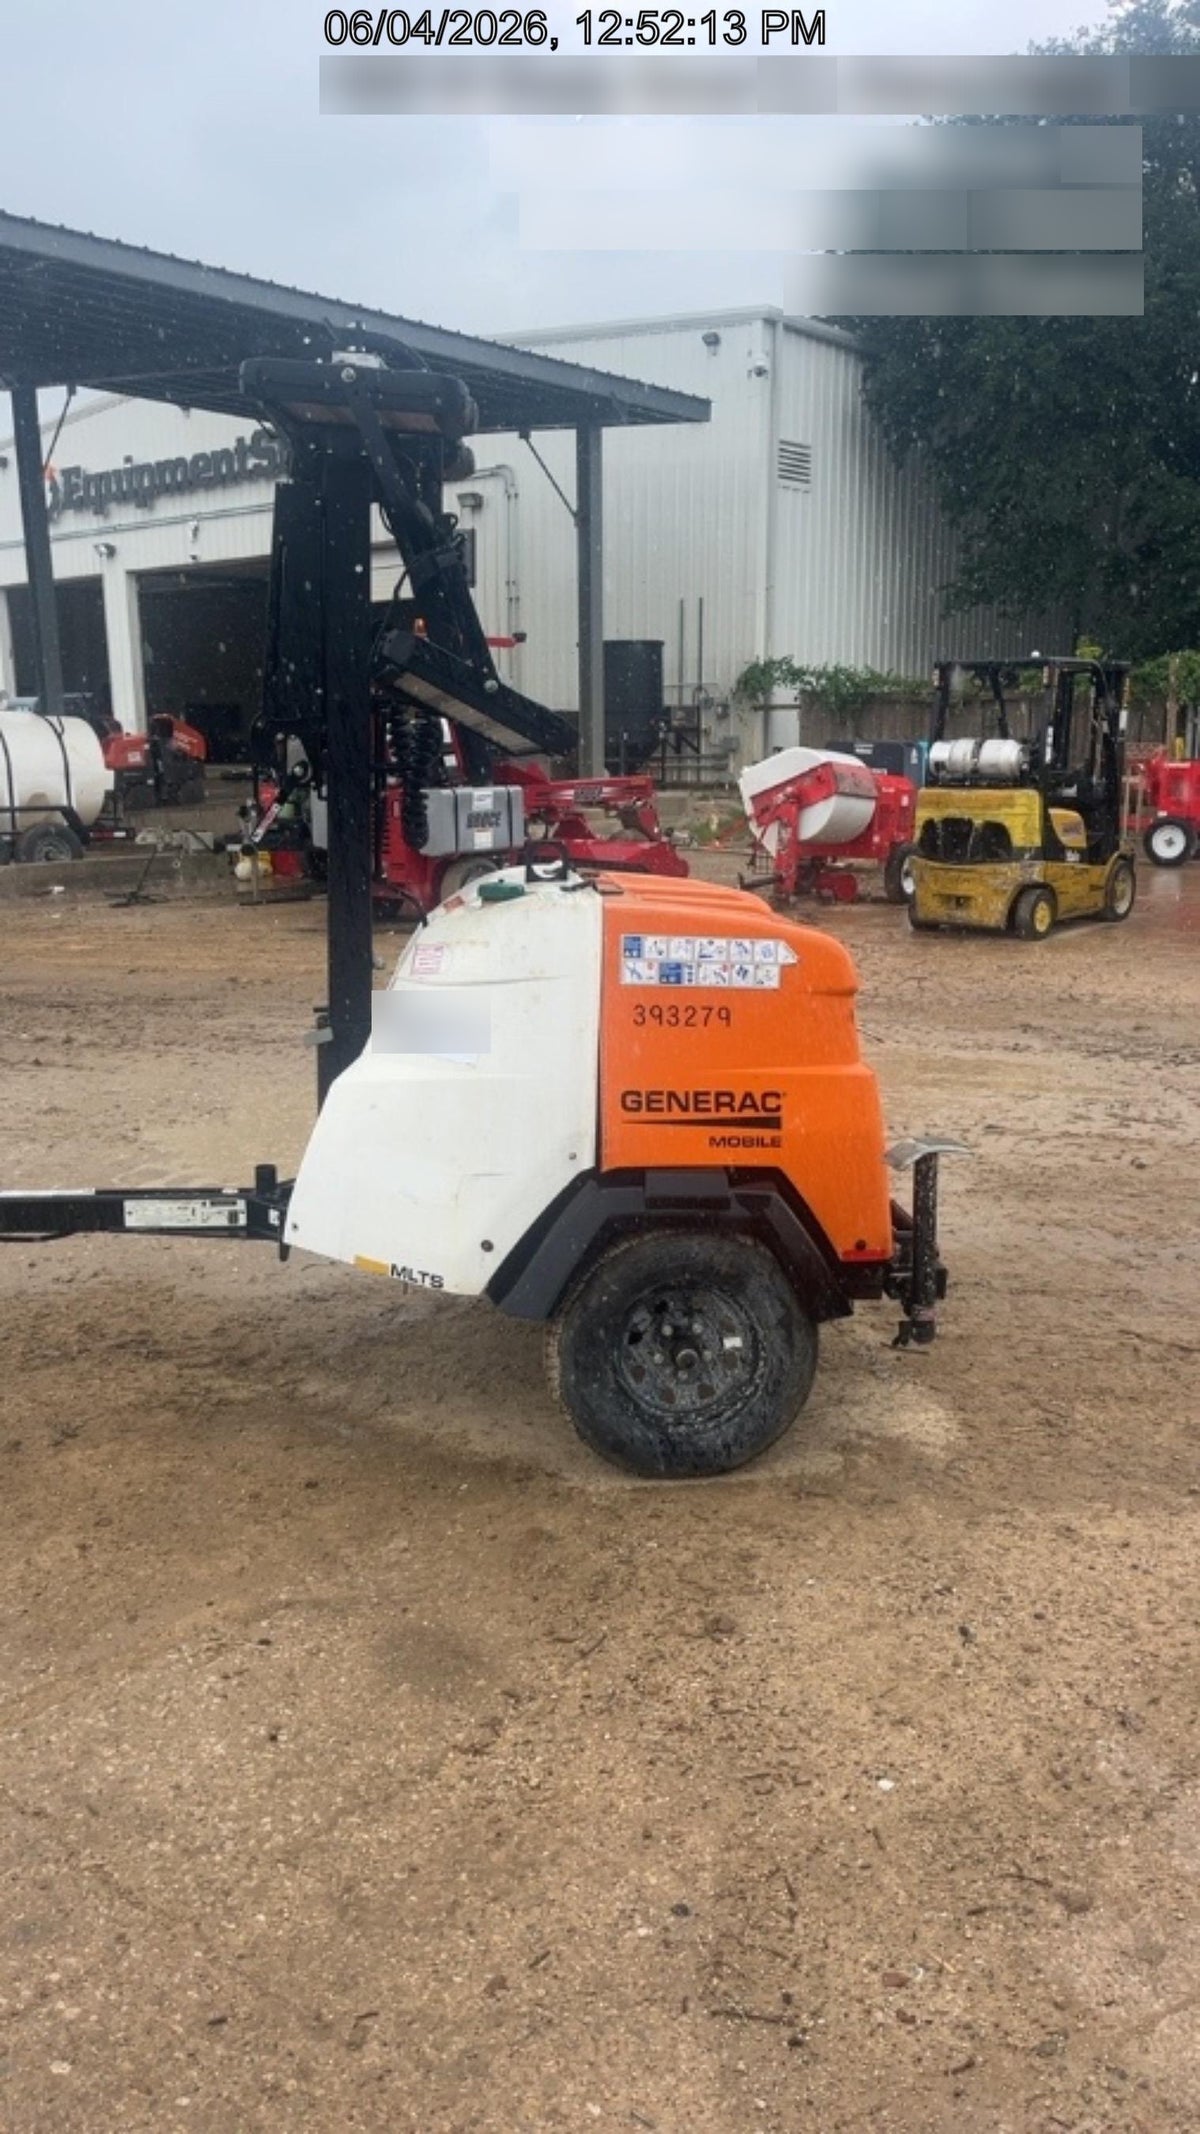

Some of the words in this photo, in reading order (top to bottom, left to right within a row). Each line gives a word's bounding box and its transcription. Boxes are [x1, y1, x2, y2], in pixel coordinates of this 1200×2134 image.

[632, 1004, 732, 1028] 393279
[620, 1090, 783, 1114] GENERAC
[708, 1135, 783, 1149] MOBILE
